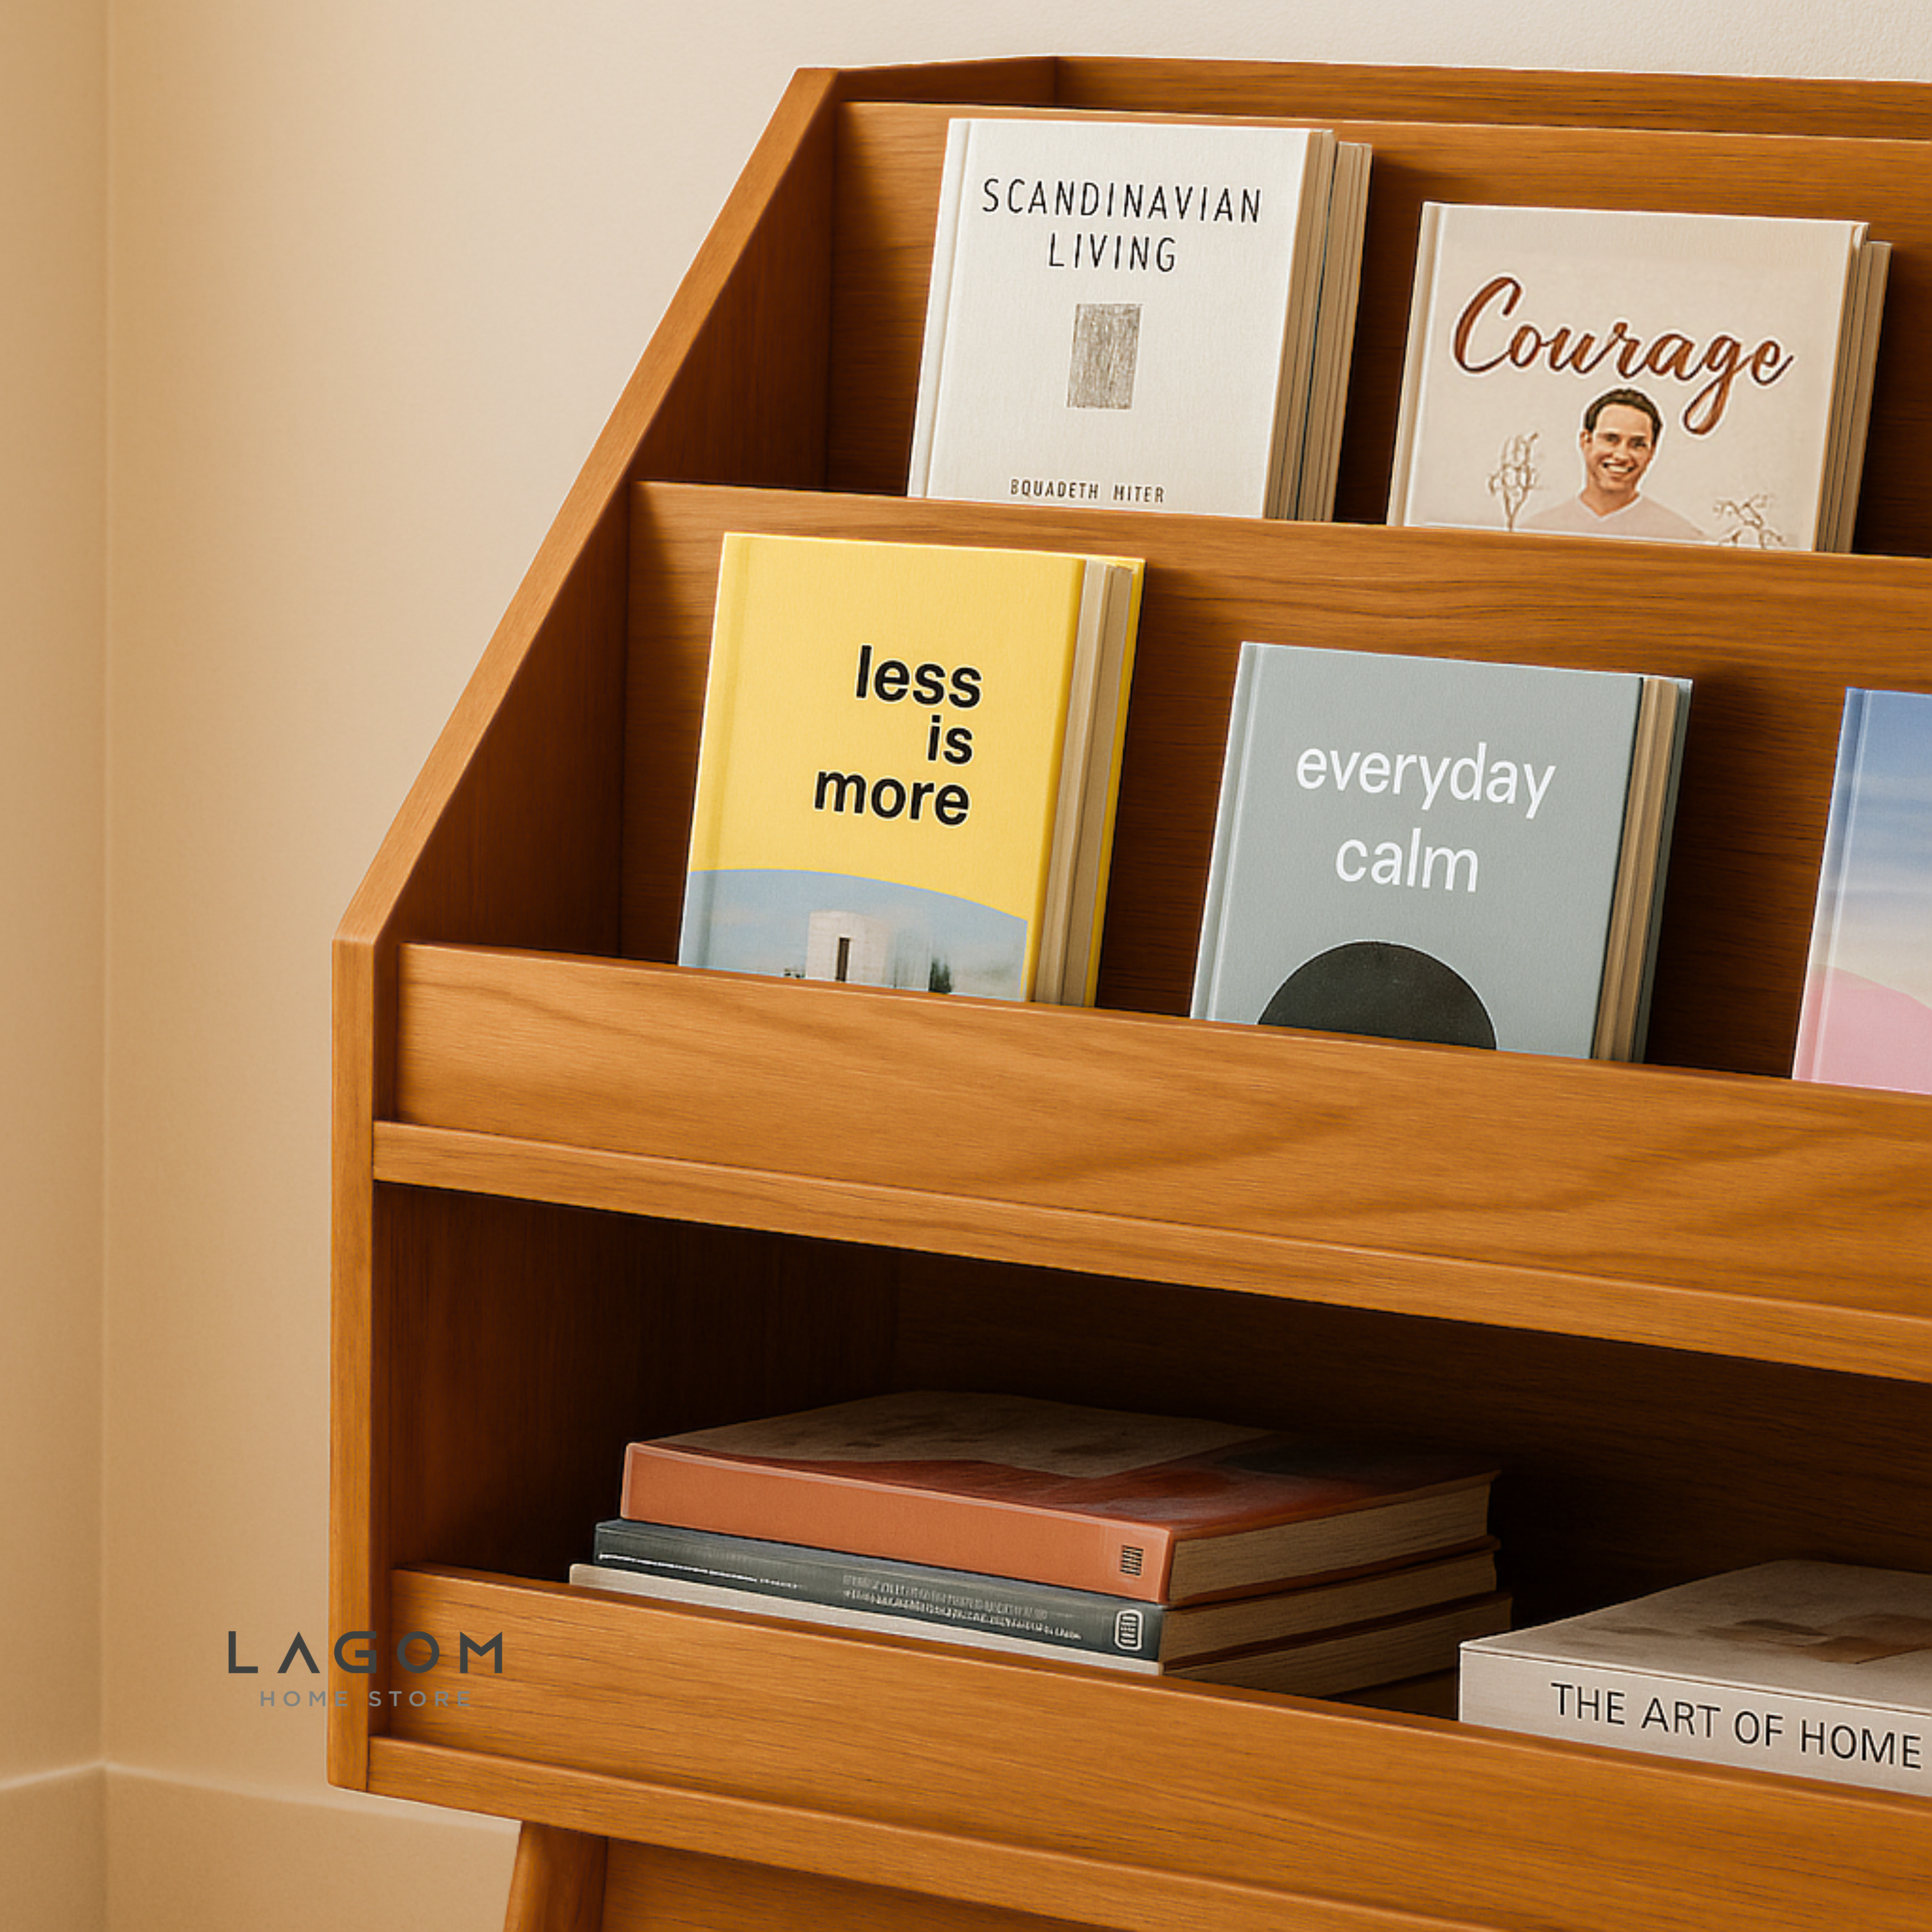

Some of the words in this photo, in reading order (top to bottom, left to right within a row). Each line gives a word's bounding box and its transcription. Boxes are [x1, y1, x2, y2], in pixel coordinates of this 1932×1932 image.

[982, 178, 1262, 223] SCANDINAVIAN
[1048, 232, 1177, 272] LIVING
[1454, 276, 1795, 435] Courage
[856, 645, 981, 708] less
[927, 714, 973, 764] is
[814, 772, 970, 826] more
[1296, 741, 1557, 820] everyday
[1335, 828, 1479, 893] calm
[1551, 1682, 1625, 1725] THE
[1641, 1698, 1721, 1738] ART
[1734, 1710, 1783, 1747] OF
[1800, 1719, 1922, 1769] HOME
